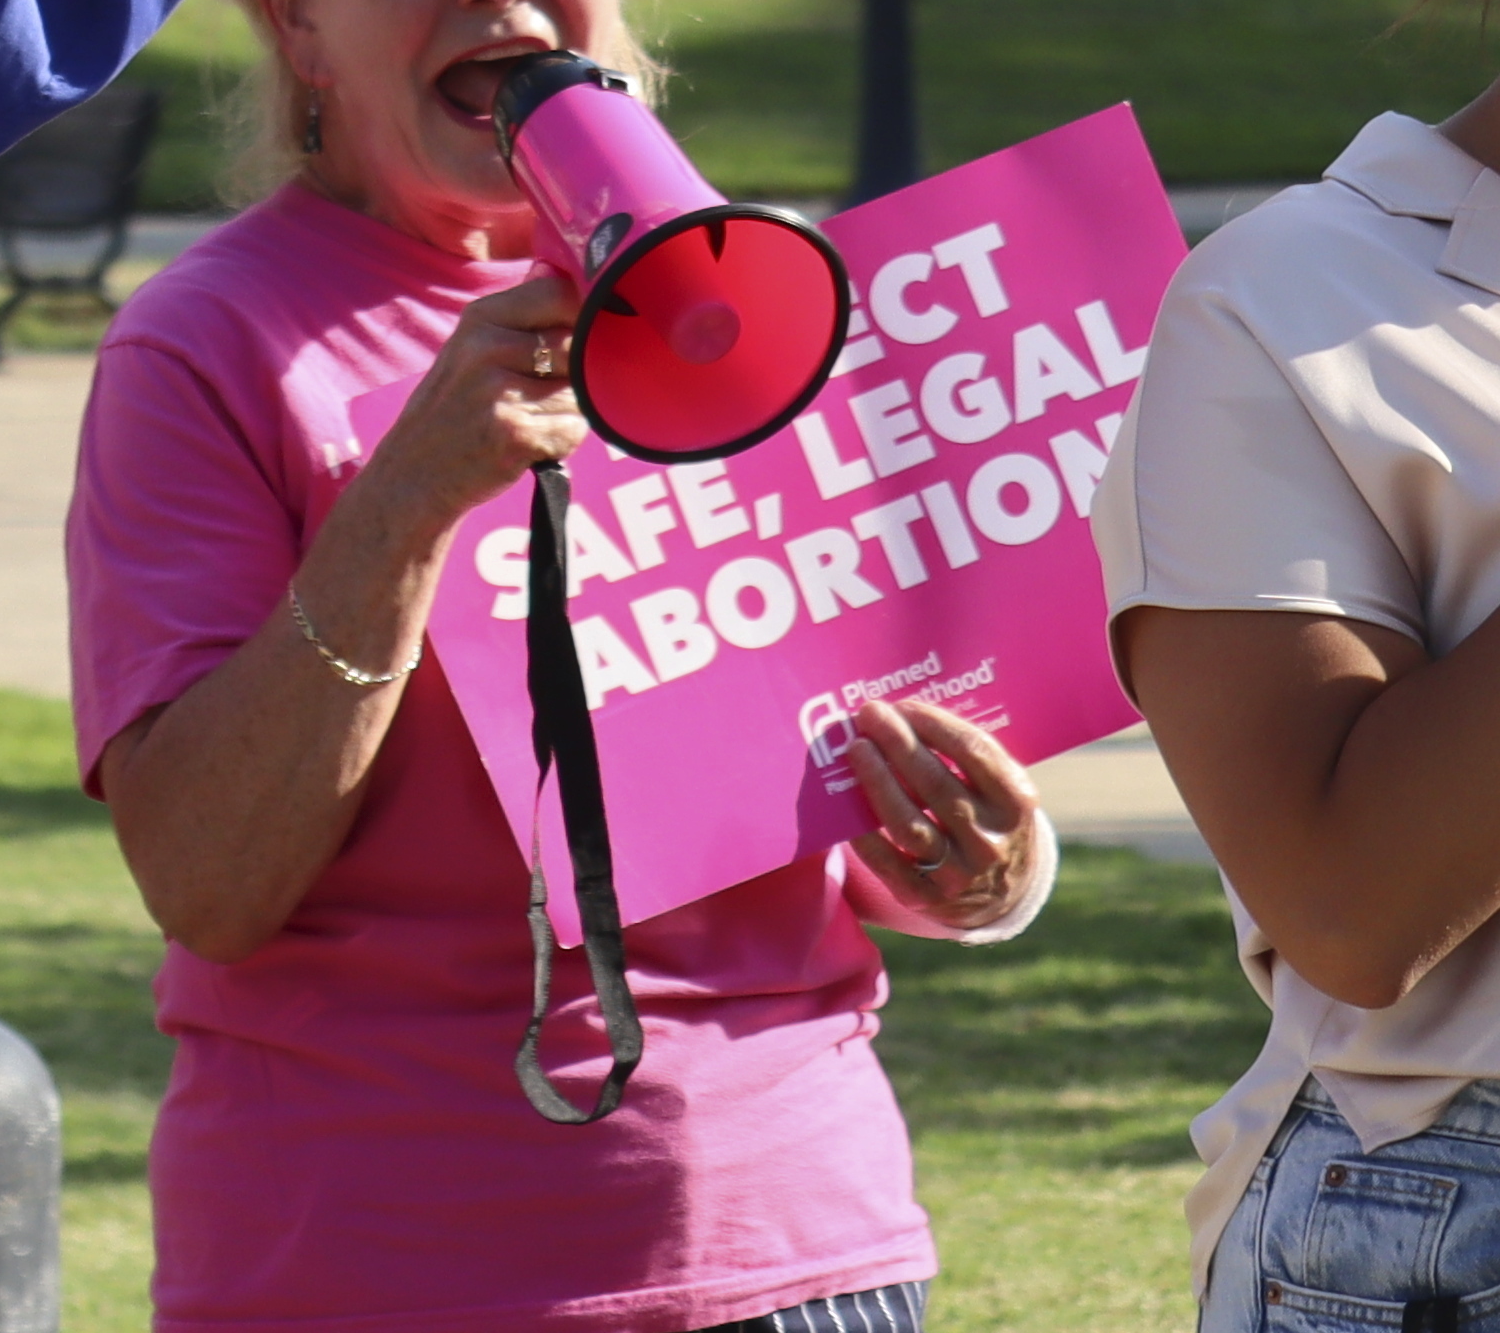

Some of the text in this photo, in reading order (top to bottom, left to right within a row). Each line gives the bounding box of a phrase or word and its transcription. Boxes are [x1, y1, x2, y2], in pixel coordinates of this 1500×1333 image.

[474, 299, 1152, 621] SAFE, LEGAL
[570, 411, 1130, 711] ABORTION
[841, 649, 943, 708] Planned
